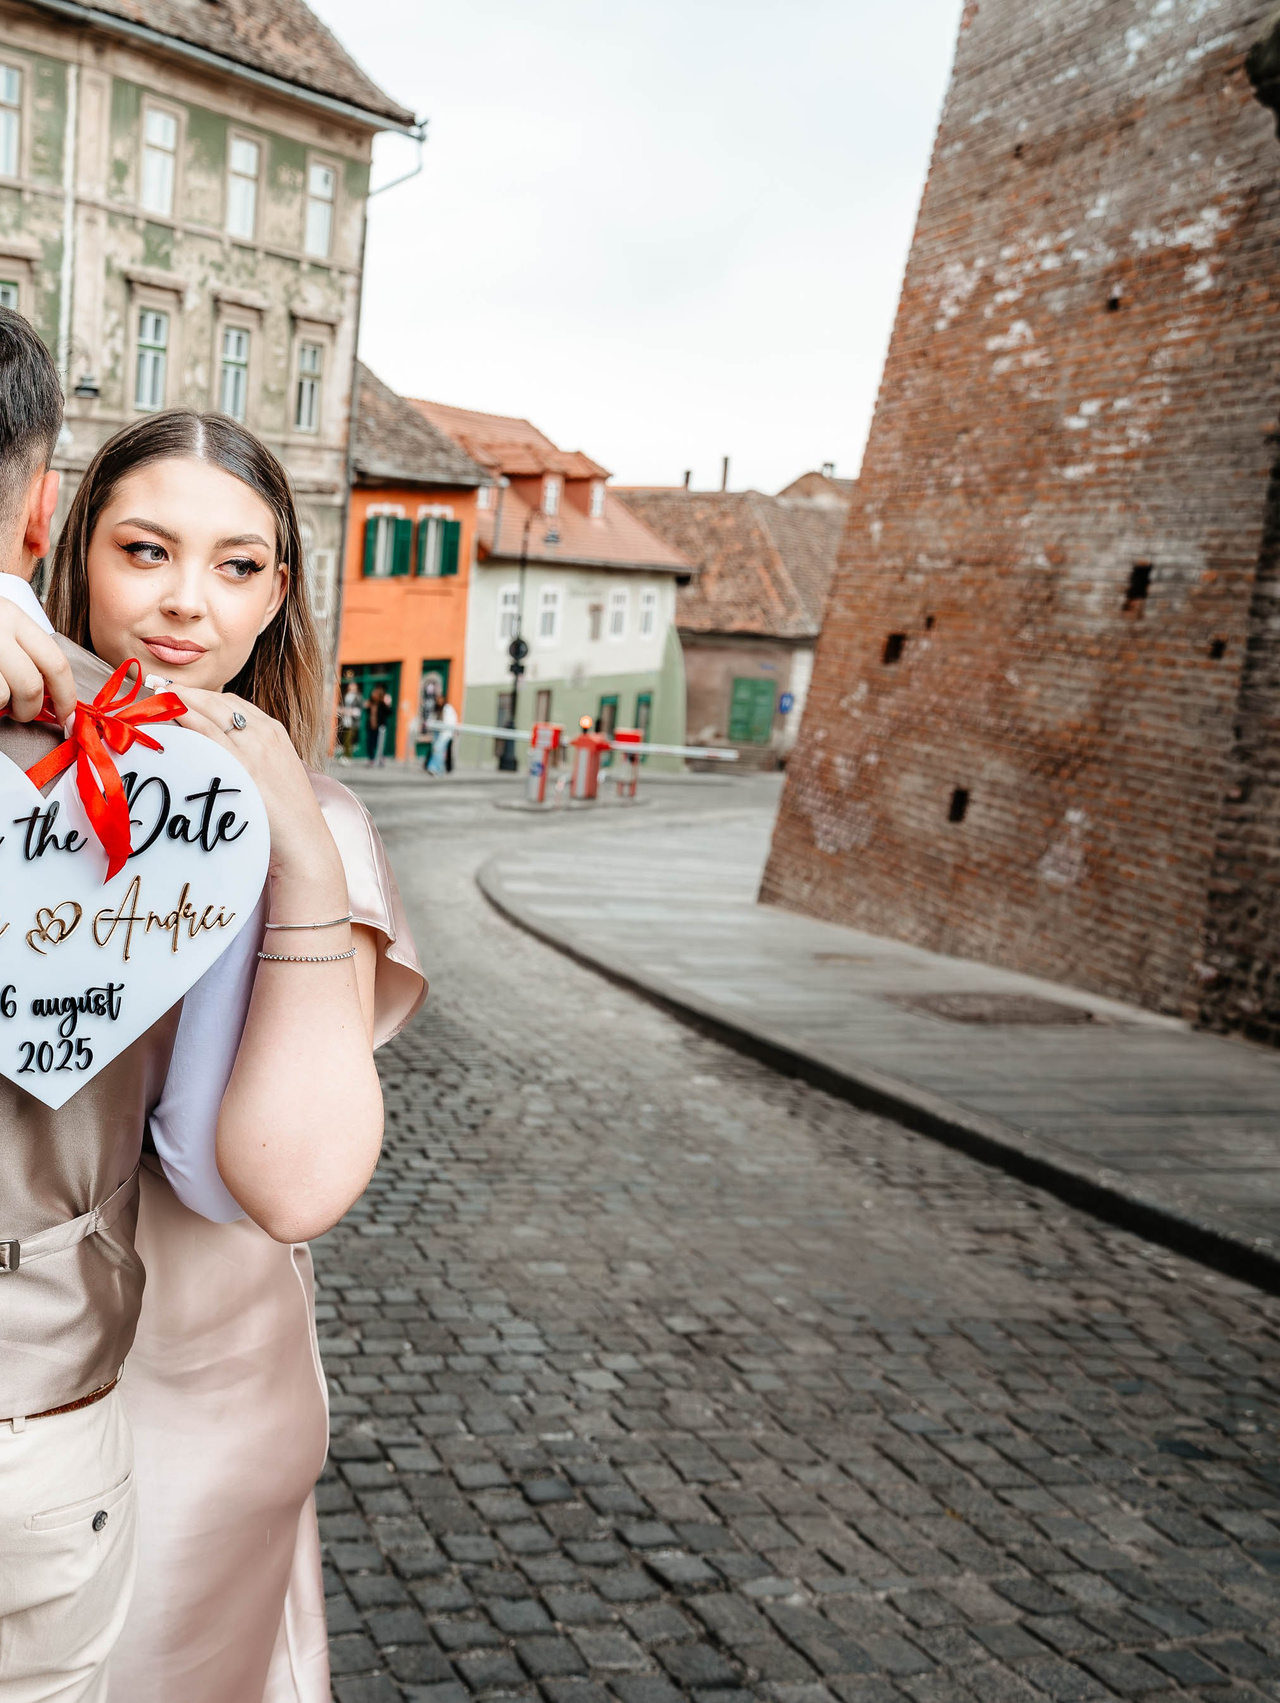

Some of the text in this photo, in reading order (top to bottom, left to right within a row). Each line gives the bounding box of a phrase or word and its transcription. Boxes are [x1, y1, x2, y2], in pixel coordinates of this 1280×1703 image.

[13, 801, 88, 861] the
[104, 771, 248, 858] Date
[92, 875, 236, 962] Andrei
[31, 982, 124, 1038] august
[17, 1038, 94, 1074] 2025
